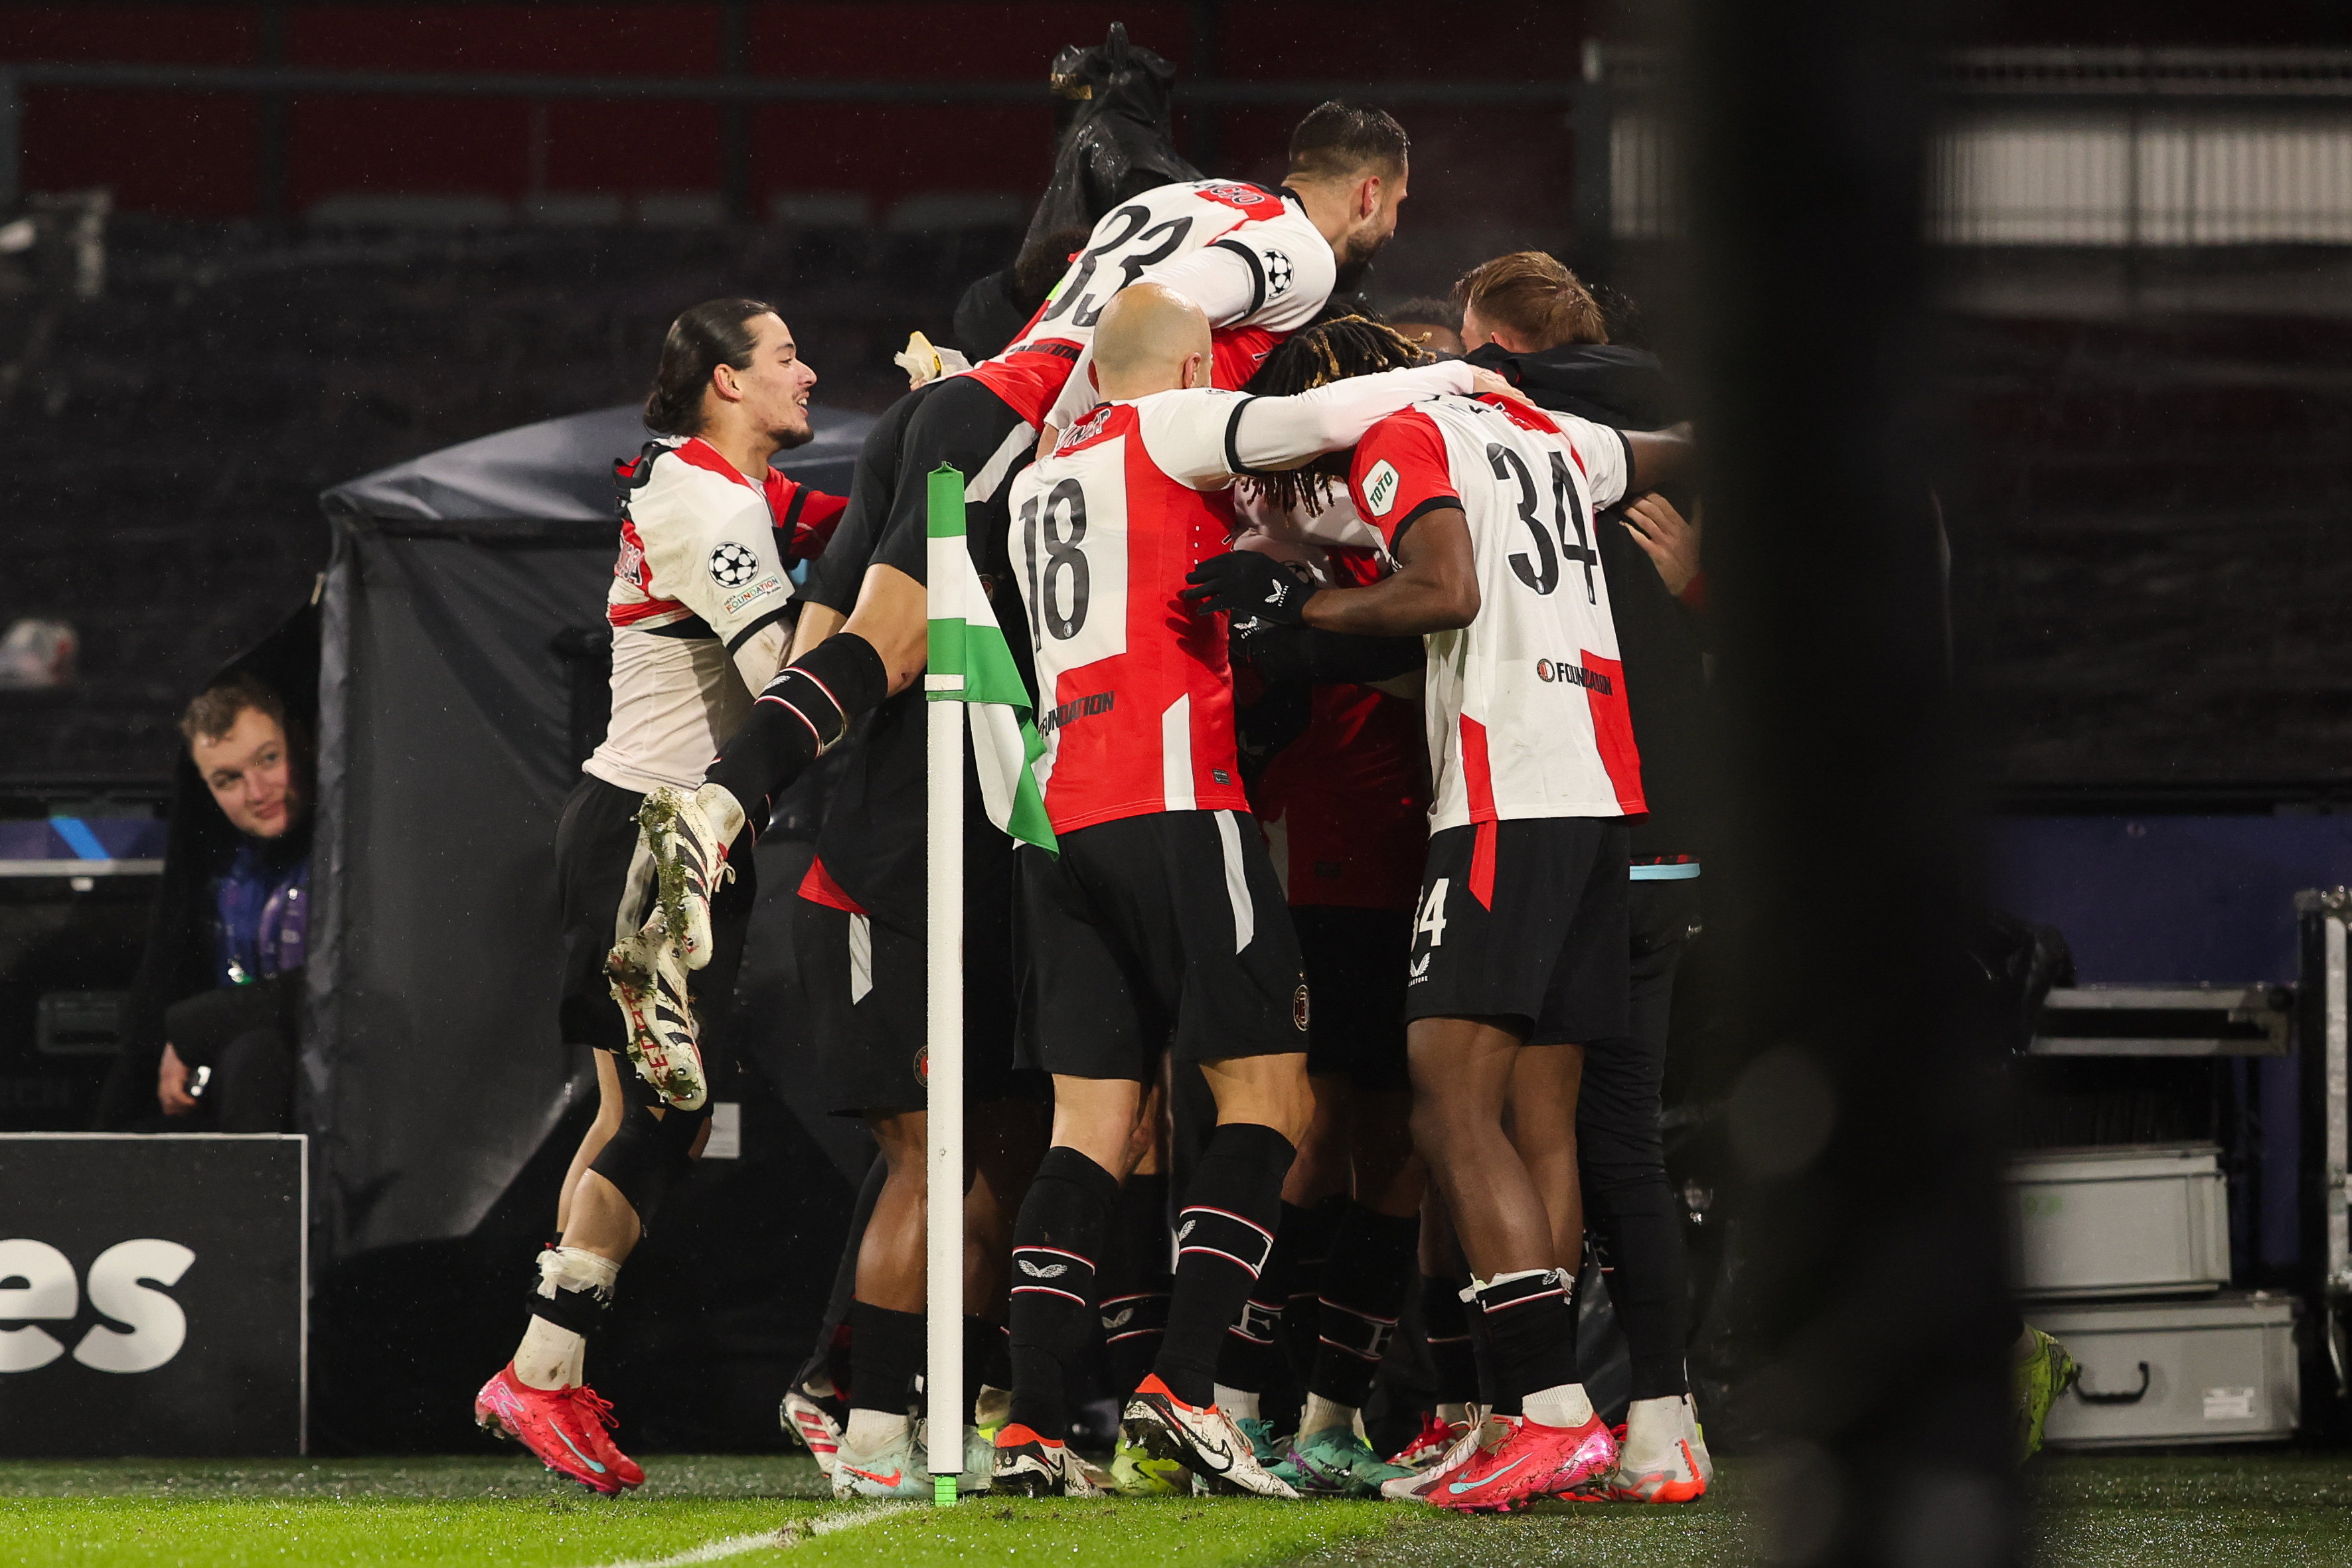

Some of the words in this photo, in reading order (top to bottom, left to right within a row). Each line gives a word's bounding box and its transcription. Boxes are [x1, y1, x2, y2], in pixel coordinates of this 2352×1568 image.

[1040, 205, 1193, 327] 33
[1370, 471, 1393, 509] TOTO
[1486, 443, 1598, 605] 34
[726, 578, 779, 614] FOUNDATION
[1018, 478, 1090, 654] 18
[1555, 662, 1613, 696] FOUNDATION
[0, 1238, 196, 1374] es
